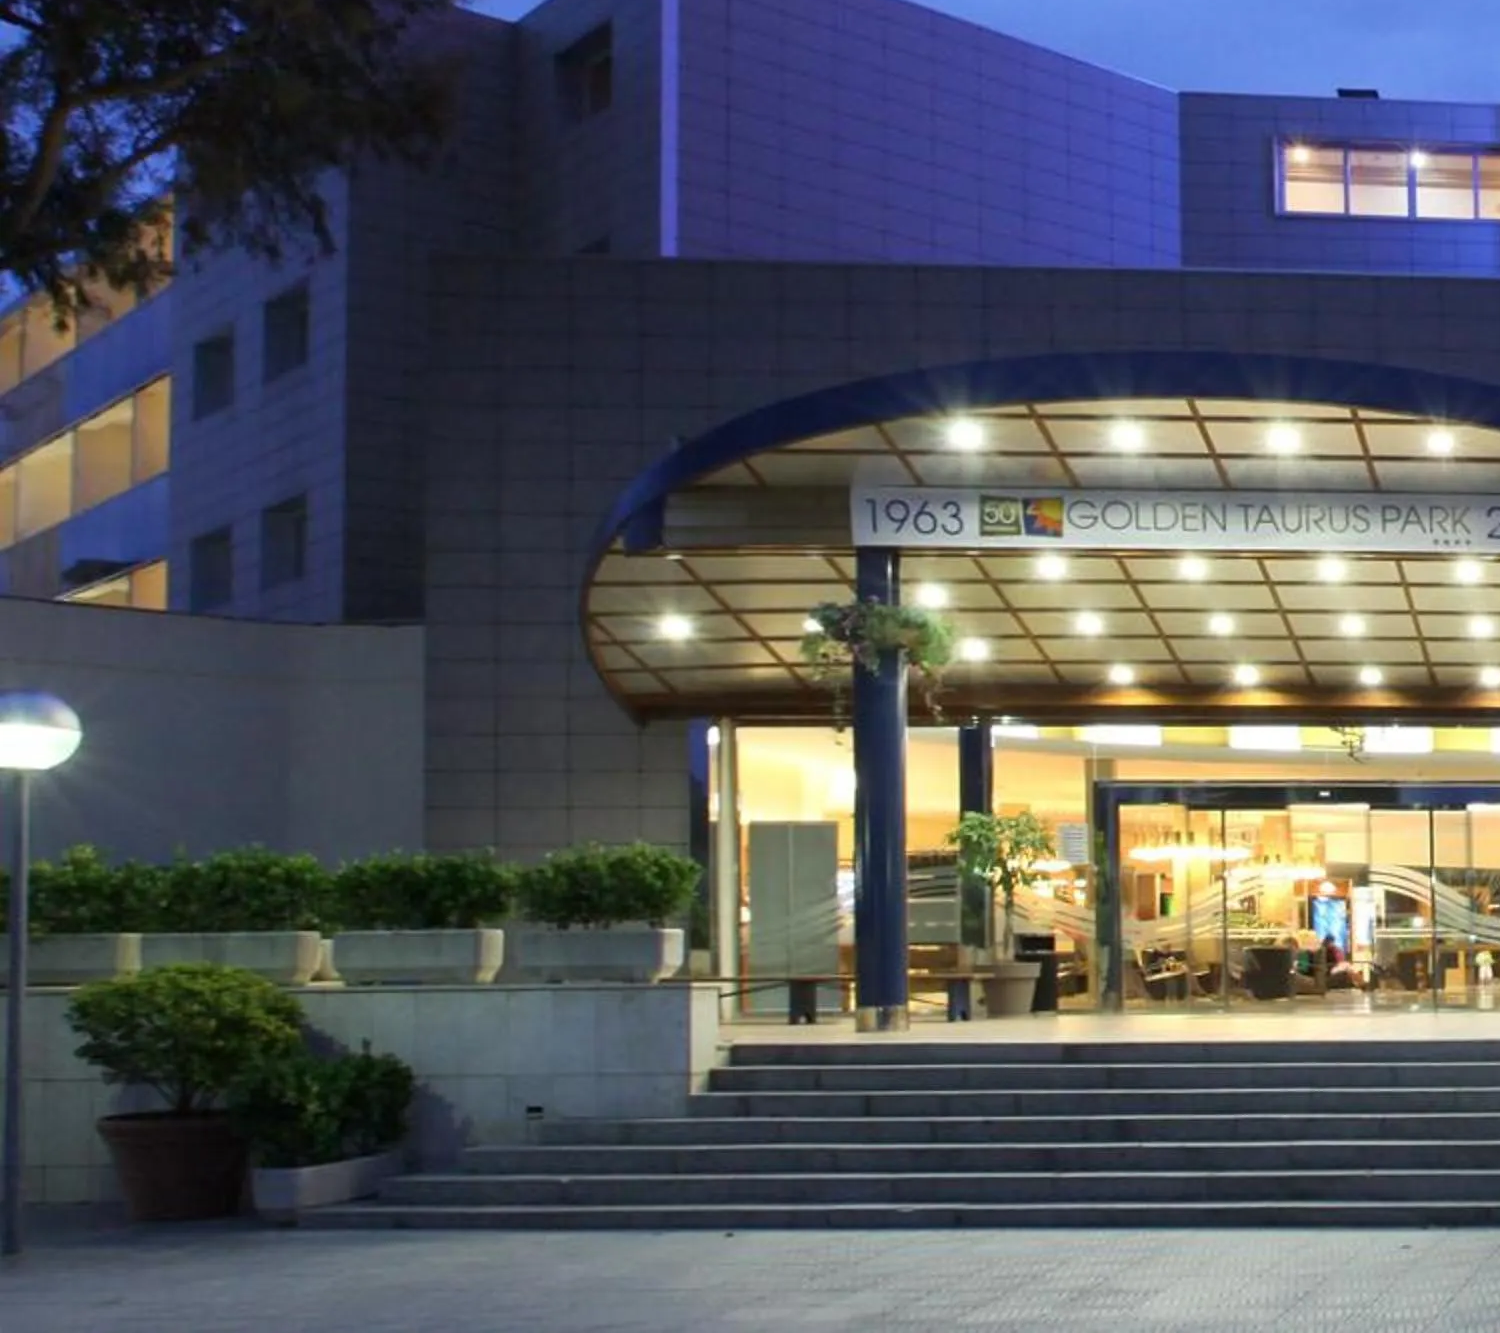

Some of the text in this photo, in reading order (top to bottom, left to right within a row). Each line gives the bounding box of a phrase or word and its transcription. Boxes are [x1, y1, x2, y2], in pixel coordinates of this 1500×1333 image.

[865, 499, 964, 536] 1963
[1067, 500, 1472, 535] GOLDEN TAURUS PARK
